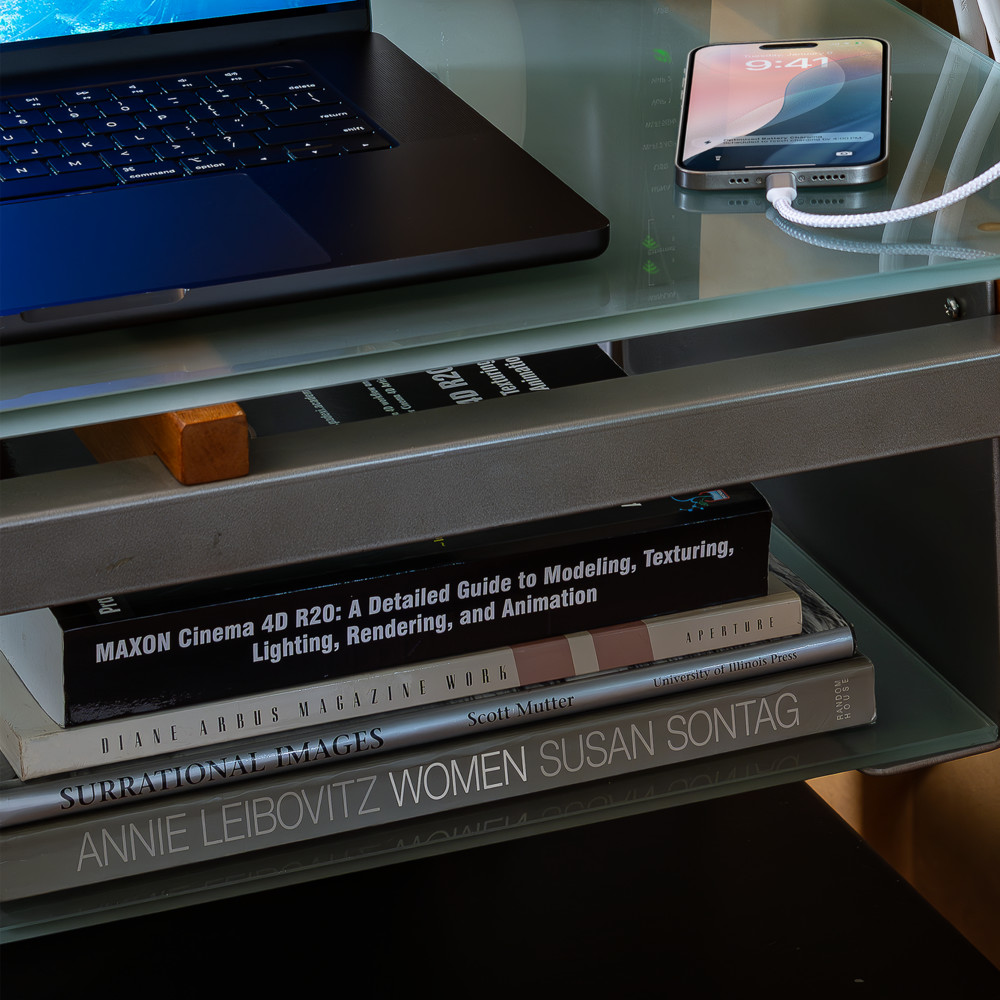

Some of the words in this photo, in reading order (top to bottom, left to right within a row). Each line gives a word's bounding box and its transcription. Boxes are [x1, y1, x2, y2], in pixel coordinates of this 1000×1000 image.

[745, 56, 829, 71] 9:41
[129, 168, 176, 179] command
[195, 162, 226, 170] option
[95, 631, 171, 664] MAXON
[178, 621, 255, 650] Cinema
[261, 612, 288, 637] 4D
[295, 604, 342, 628] R20:
[348, 599, 362, 618] A
[368, 583, 450, 616] Detailed
[456, 574, 512, 600] Guide
[517, 571, 537, 589] to
[543, 557, 637, 587] Modeling,
[643, 536, 735, 569] Texturing,
[252, 632, 340, 665] Lighting,
[345, 613, 453, 647] Rendering,
[459, 604, 496, 627] and
[501, 587, 598, 619] Animation
[685, 615, 775, 644] APERTURE
[653, 668, 710, 689] University
[713, 664, 727, 677] of
[728, 656, 768, 673] Illinois
[770, 650, 798, 665] Press
[101, 724, 178, 755] DIANE
[199, 706, 280, 736] ARBUS
[298, 678, 428, 719] MAGAZINE
[445, 664, 508, 691] WORK
[467, 705, 511, 728] Scott
[516, 693, 575, 718] Mutter
[834, 680, 844, 720] RANDOM
[841, 678, 851, 720] HOUSE
[59, 751, 266, 811] SURRATIONAL
[275, 726, 386, 767] IMAGES
[76, 811, 190, 872] ANNIE
[201, 774, 381, 848] LEIBOVITZ
[388, 746, 529, 807] WOMEN
[540, 721, 655, 778] SUSAN
[666, 692, 800, 753] SONTAG
